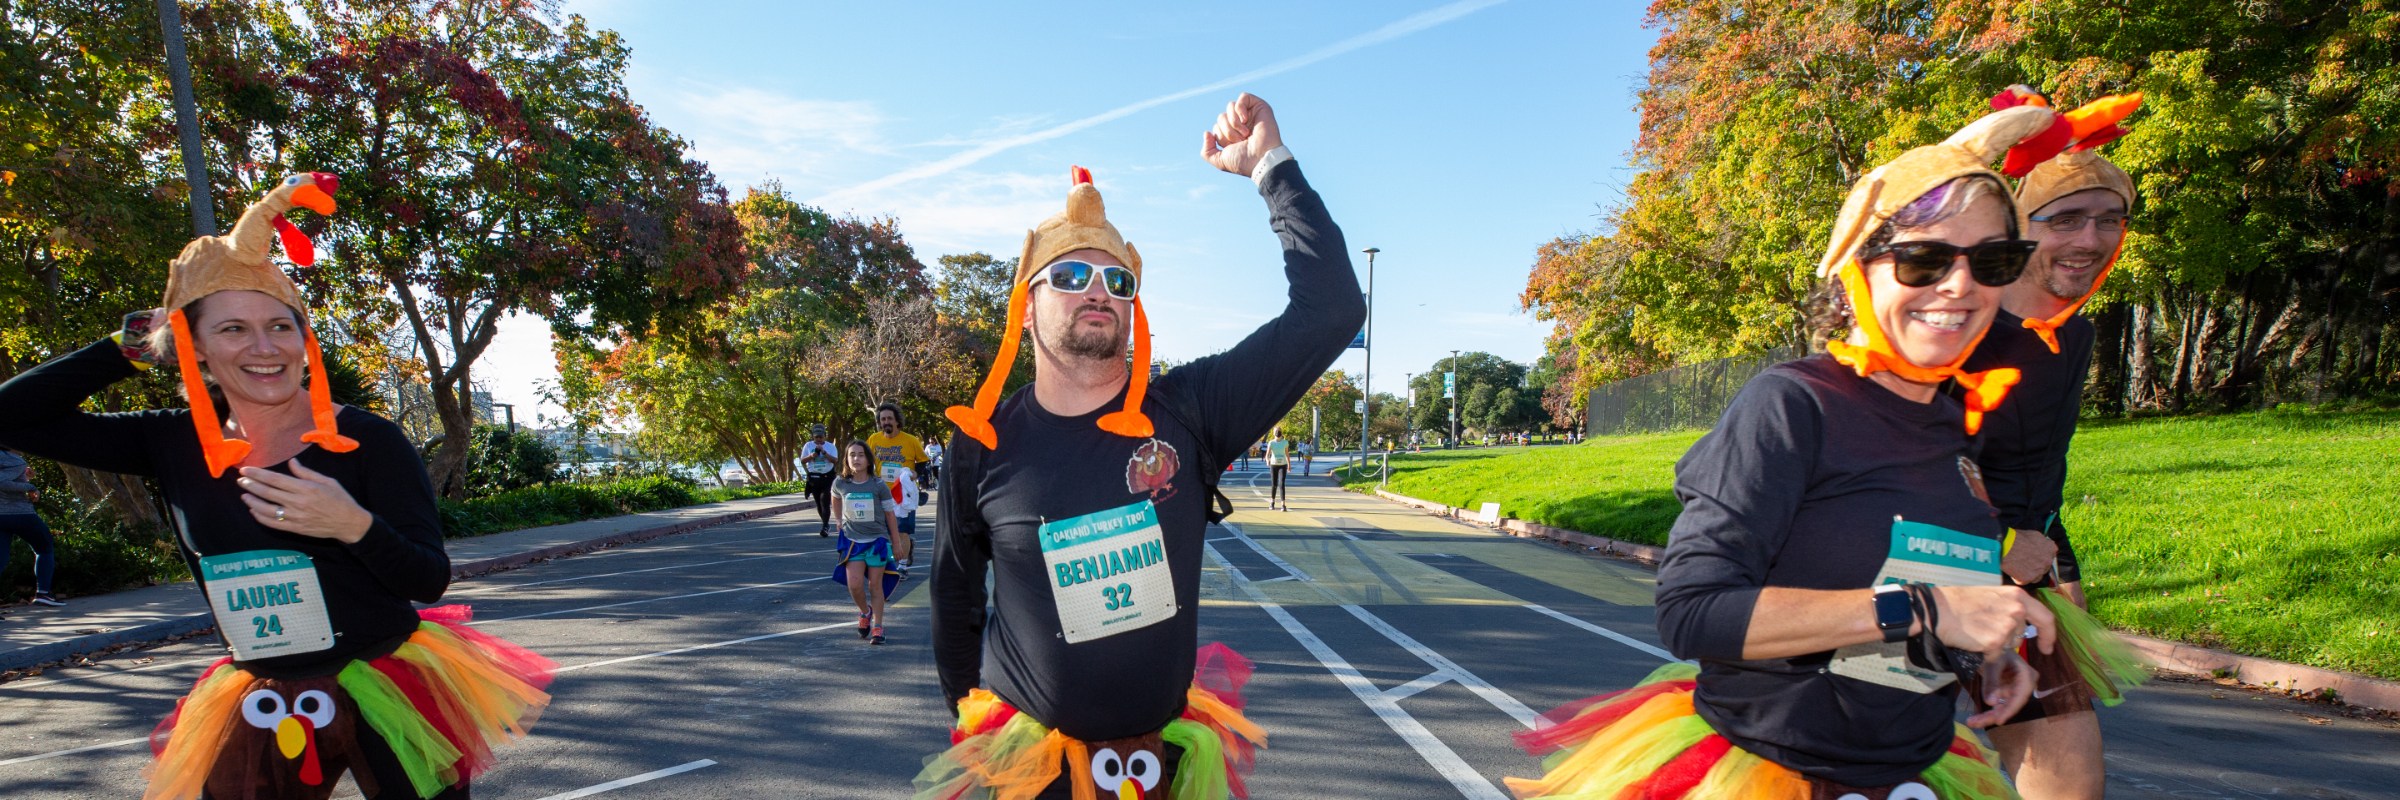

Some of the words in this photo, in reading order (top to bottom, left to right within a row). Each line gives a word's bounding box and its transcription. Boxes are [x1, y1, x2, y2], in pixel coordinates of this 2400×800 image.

[1053, 525, 1091, 543] OAKLAND
[1092, 516, 1123, 535] TURKEY
[1125, 510, 1147, 527] TROT
[1054, 538, 1164, 588] BENJAMIN
[226, 581, 304, 612] LAURIE
[1102, 582, 1135, 611] 32
[252, 614, 284, 639] 24
